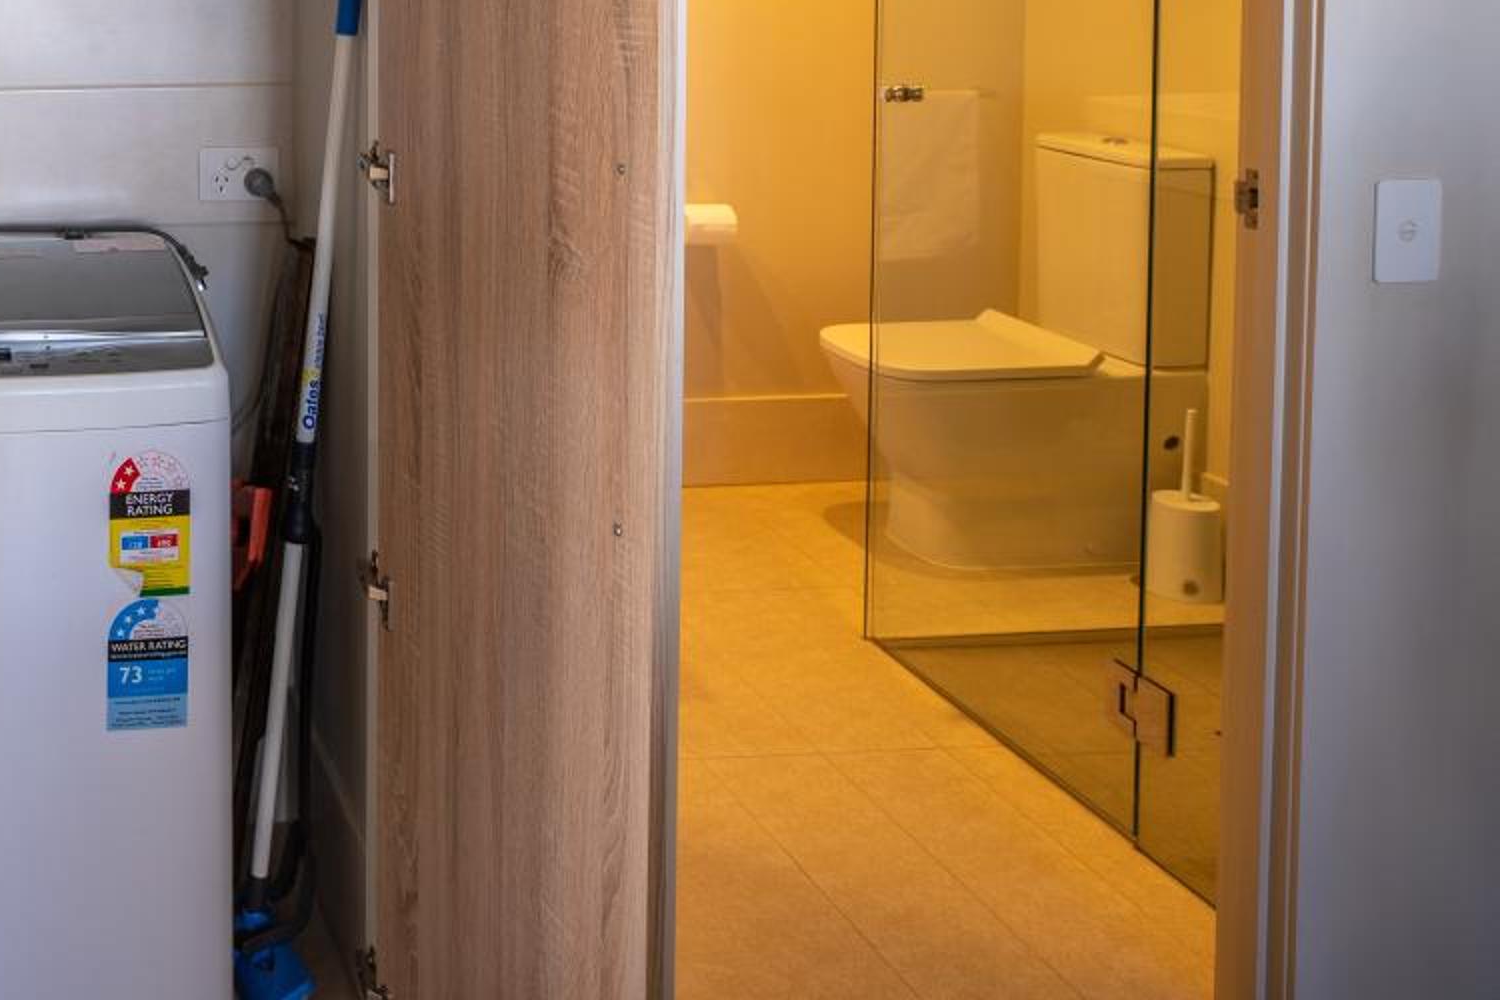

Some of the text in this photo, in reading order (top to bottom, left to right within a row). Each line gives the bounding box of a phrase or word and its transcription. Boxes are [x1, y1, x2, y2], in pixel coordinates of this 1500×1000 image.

[126, 492, 174, 505] ENERGY
[127, 504, 173, 516] RATING
[111, 639, 187, 653] WATER RATING
[119, 665, 143, 684] 73
